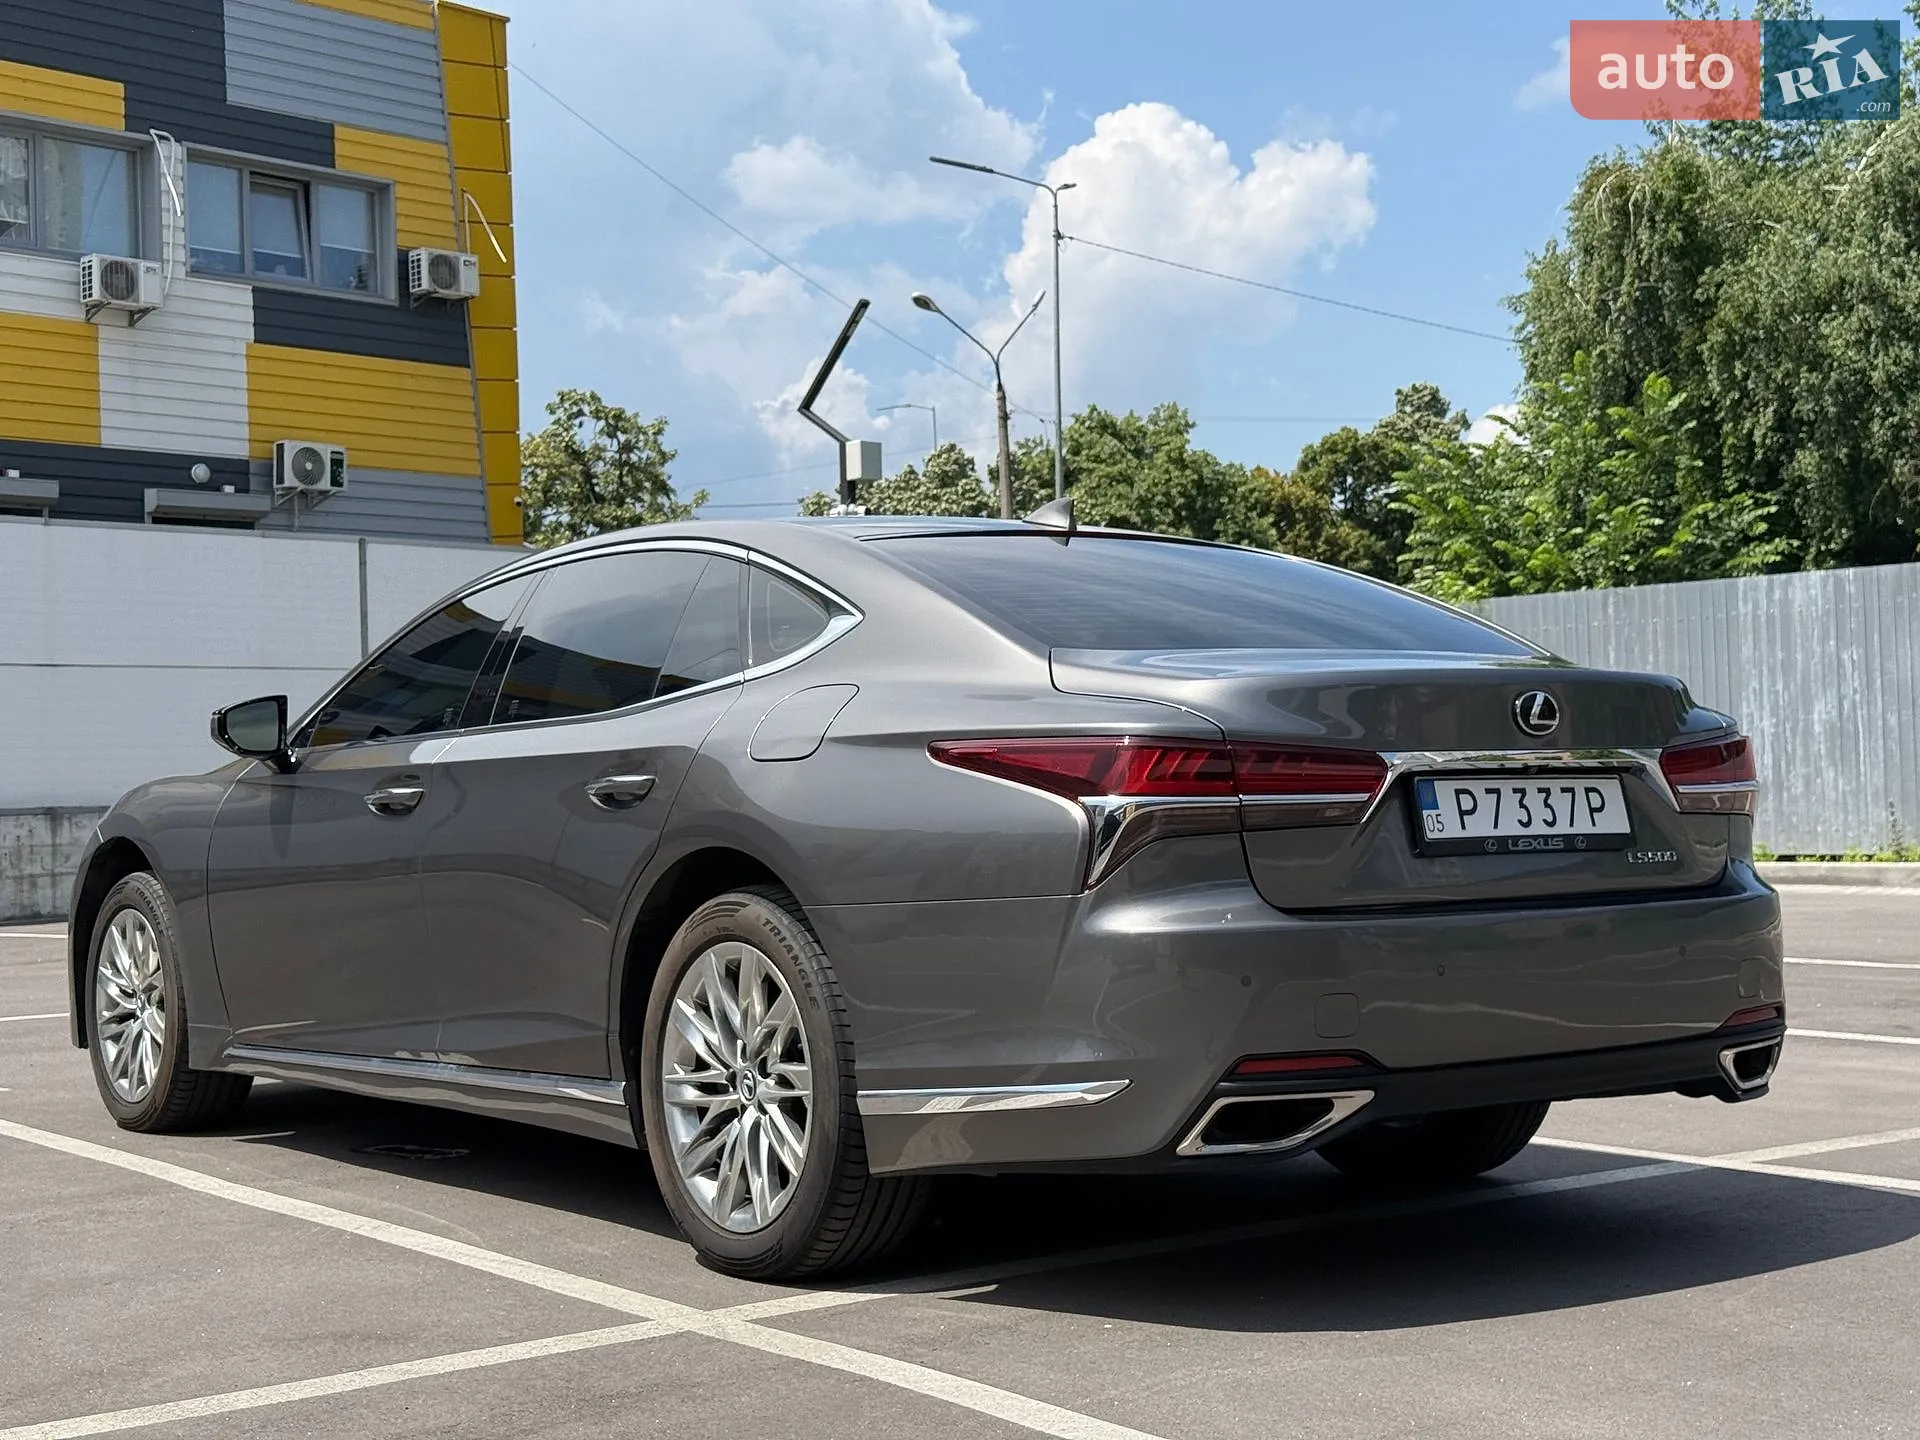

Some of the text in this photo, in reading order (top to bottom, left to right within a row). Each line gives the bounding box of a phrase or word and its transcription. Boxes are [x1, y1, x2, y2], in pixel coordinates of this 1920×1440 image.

[1454, 786, 1606, 830] P7337P
[1425, 813, 1445, 833] 05
[1508, 837, 1564, 850] LEXUS
[1627, 850, 1678, 863] LS500
[761, 917, 820, 1010] TRIANGLE
